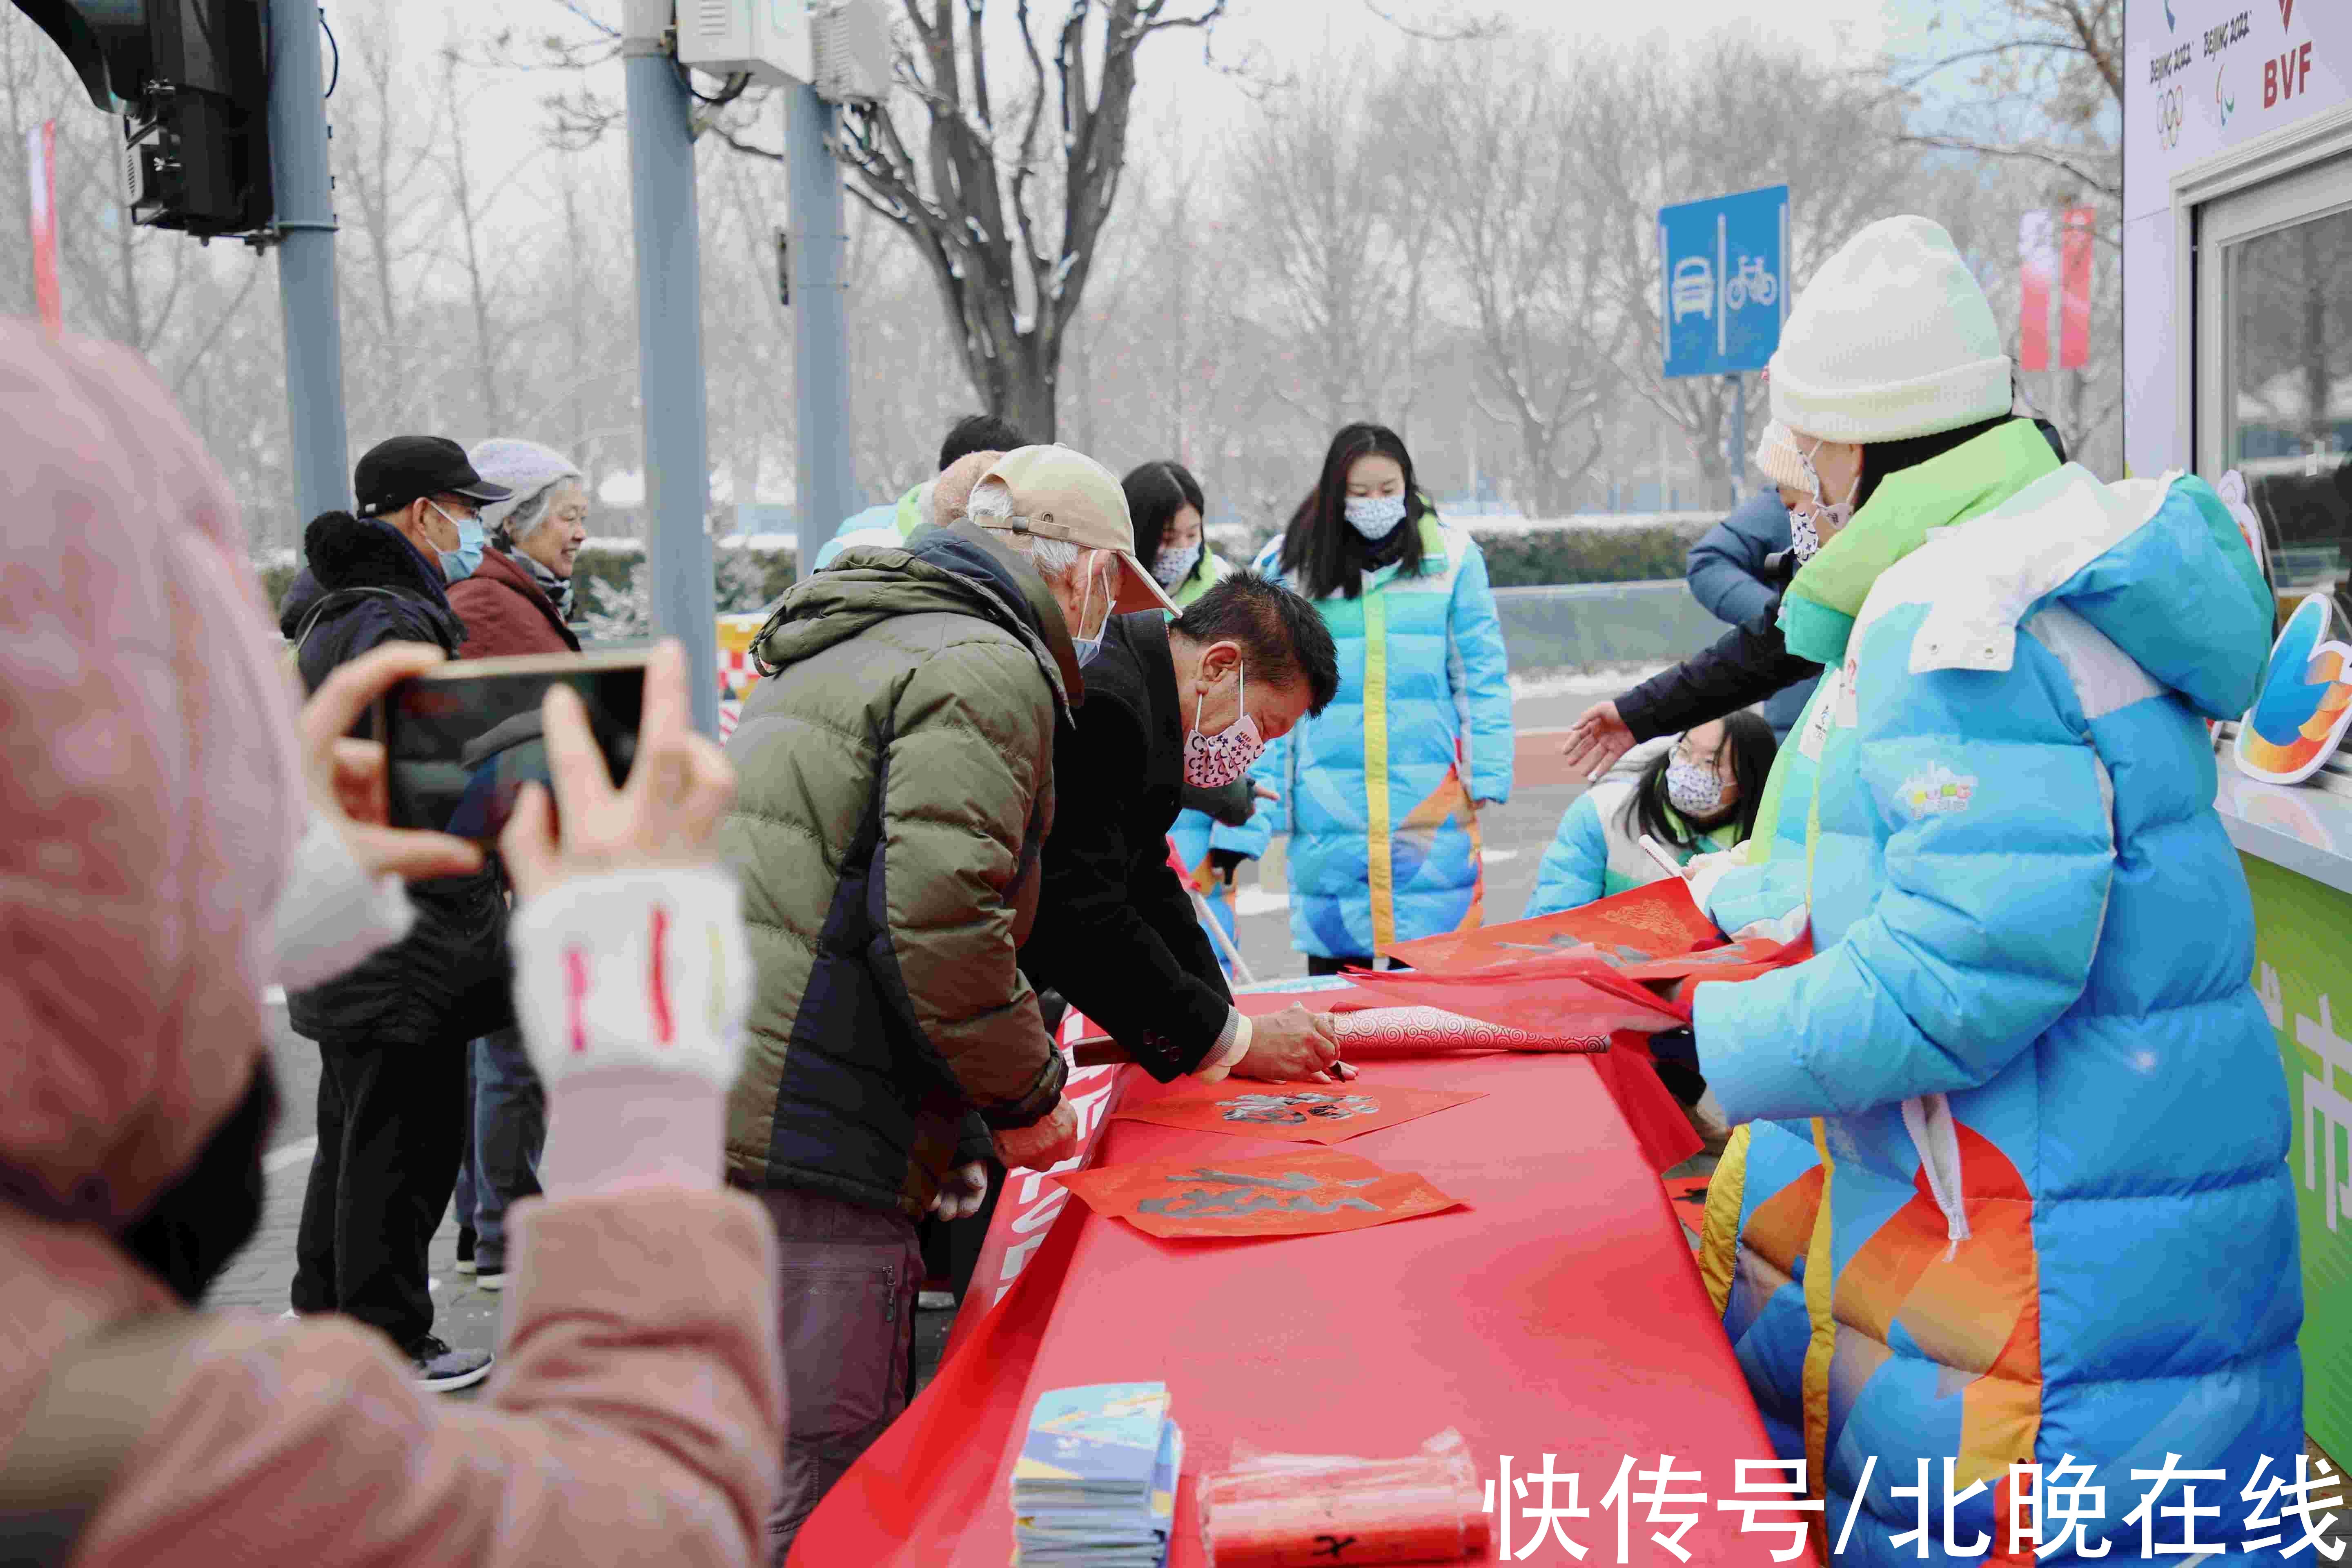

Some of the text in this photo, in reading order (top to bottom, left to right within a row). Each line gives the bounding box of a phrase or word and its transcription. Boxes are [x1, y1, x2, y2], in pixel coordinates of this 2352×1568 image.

[2204, 11, 2250, 62] BEIJING 2022
[2150, 42, 2192, 88] BEIJING 2022
[2263, 41, 2312, 109] BVF
